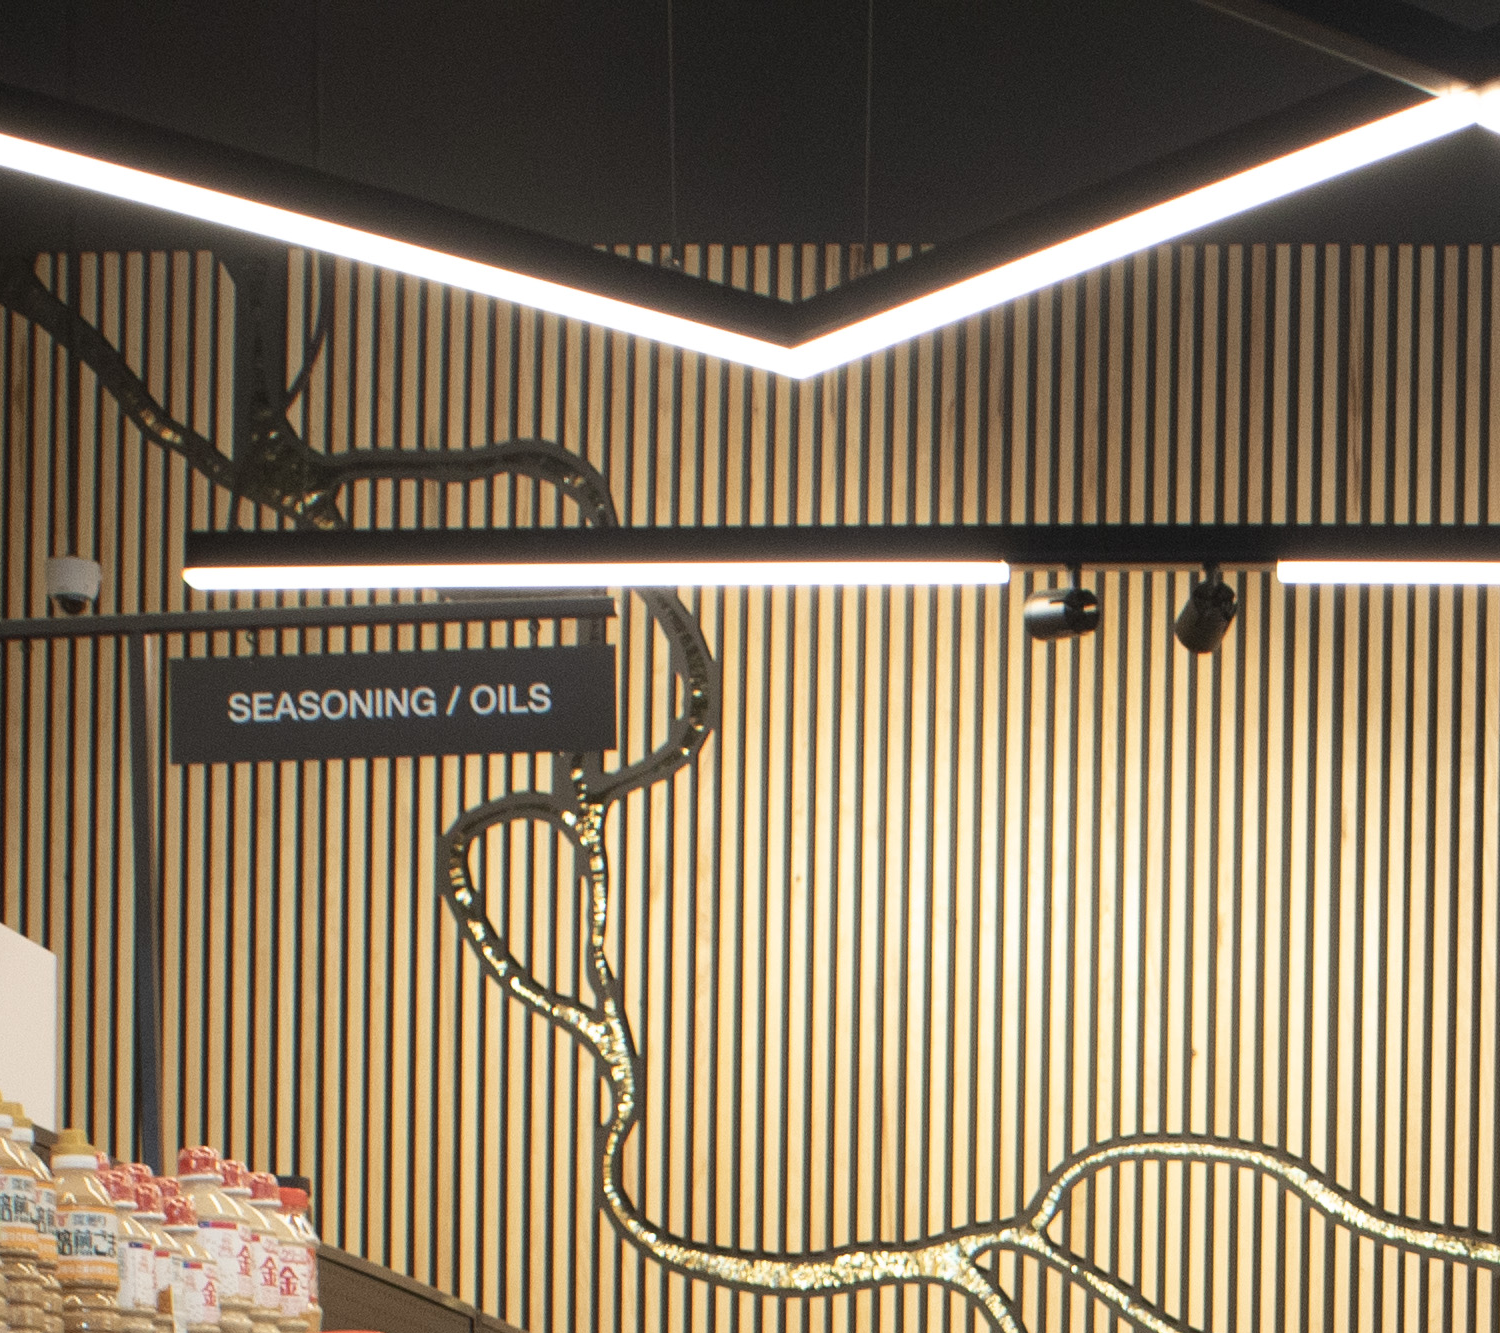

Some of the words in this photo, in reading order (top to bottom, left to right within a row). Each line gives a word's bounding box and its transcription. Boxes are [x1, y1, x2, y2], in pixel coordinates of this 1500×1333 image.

[228, 686, 437, 723] SEASONING
[445, 685, 461, 716] /
[469, 682, 552, 715] OILS
